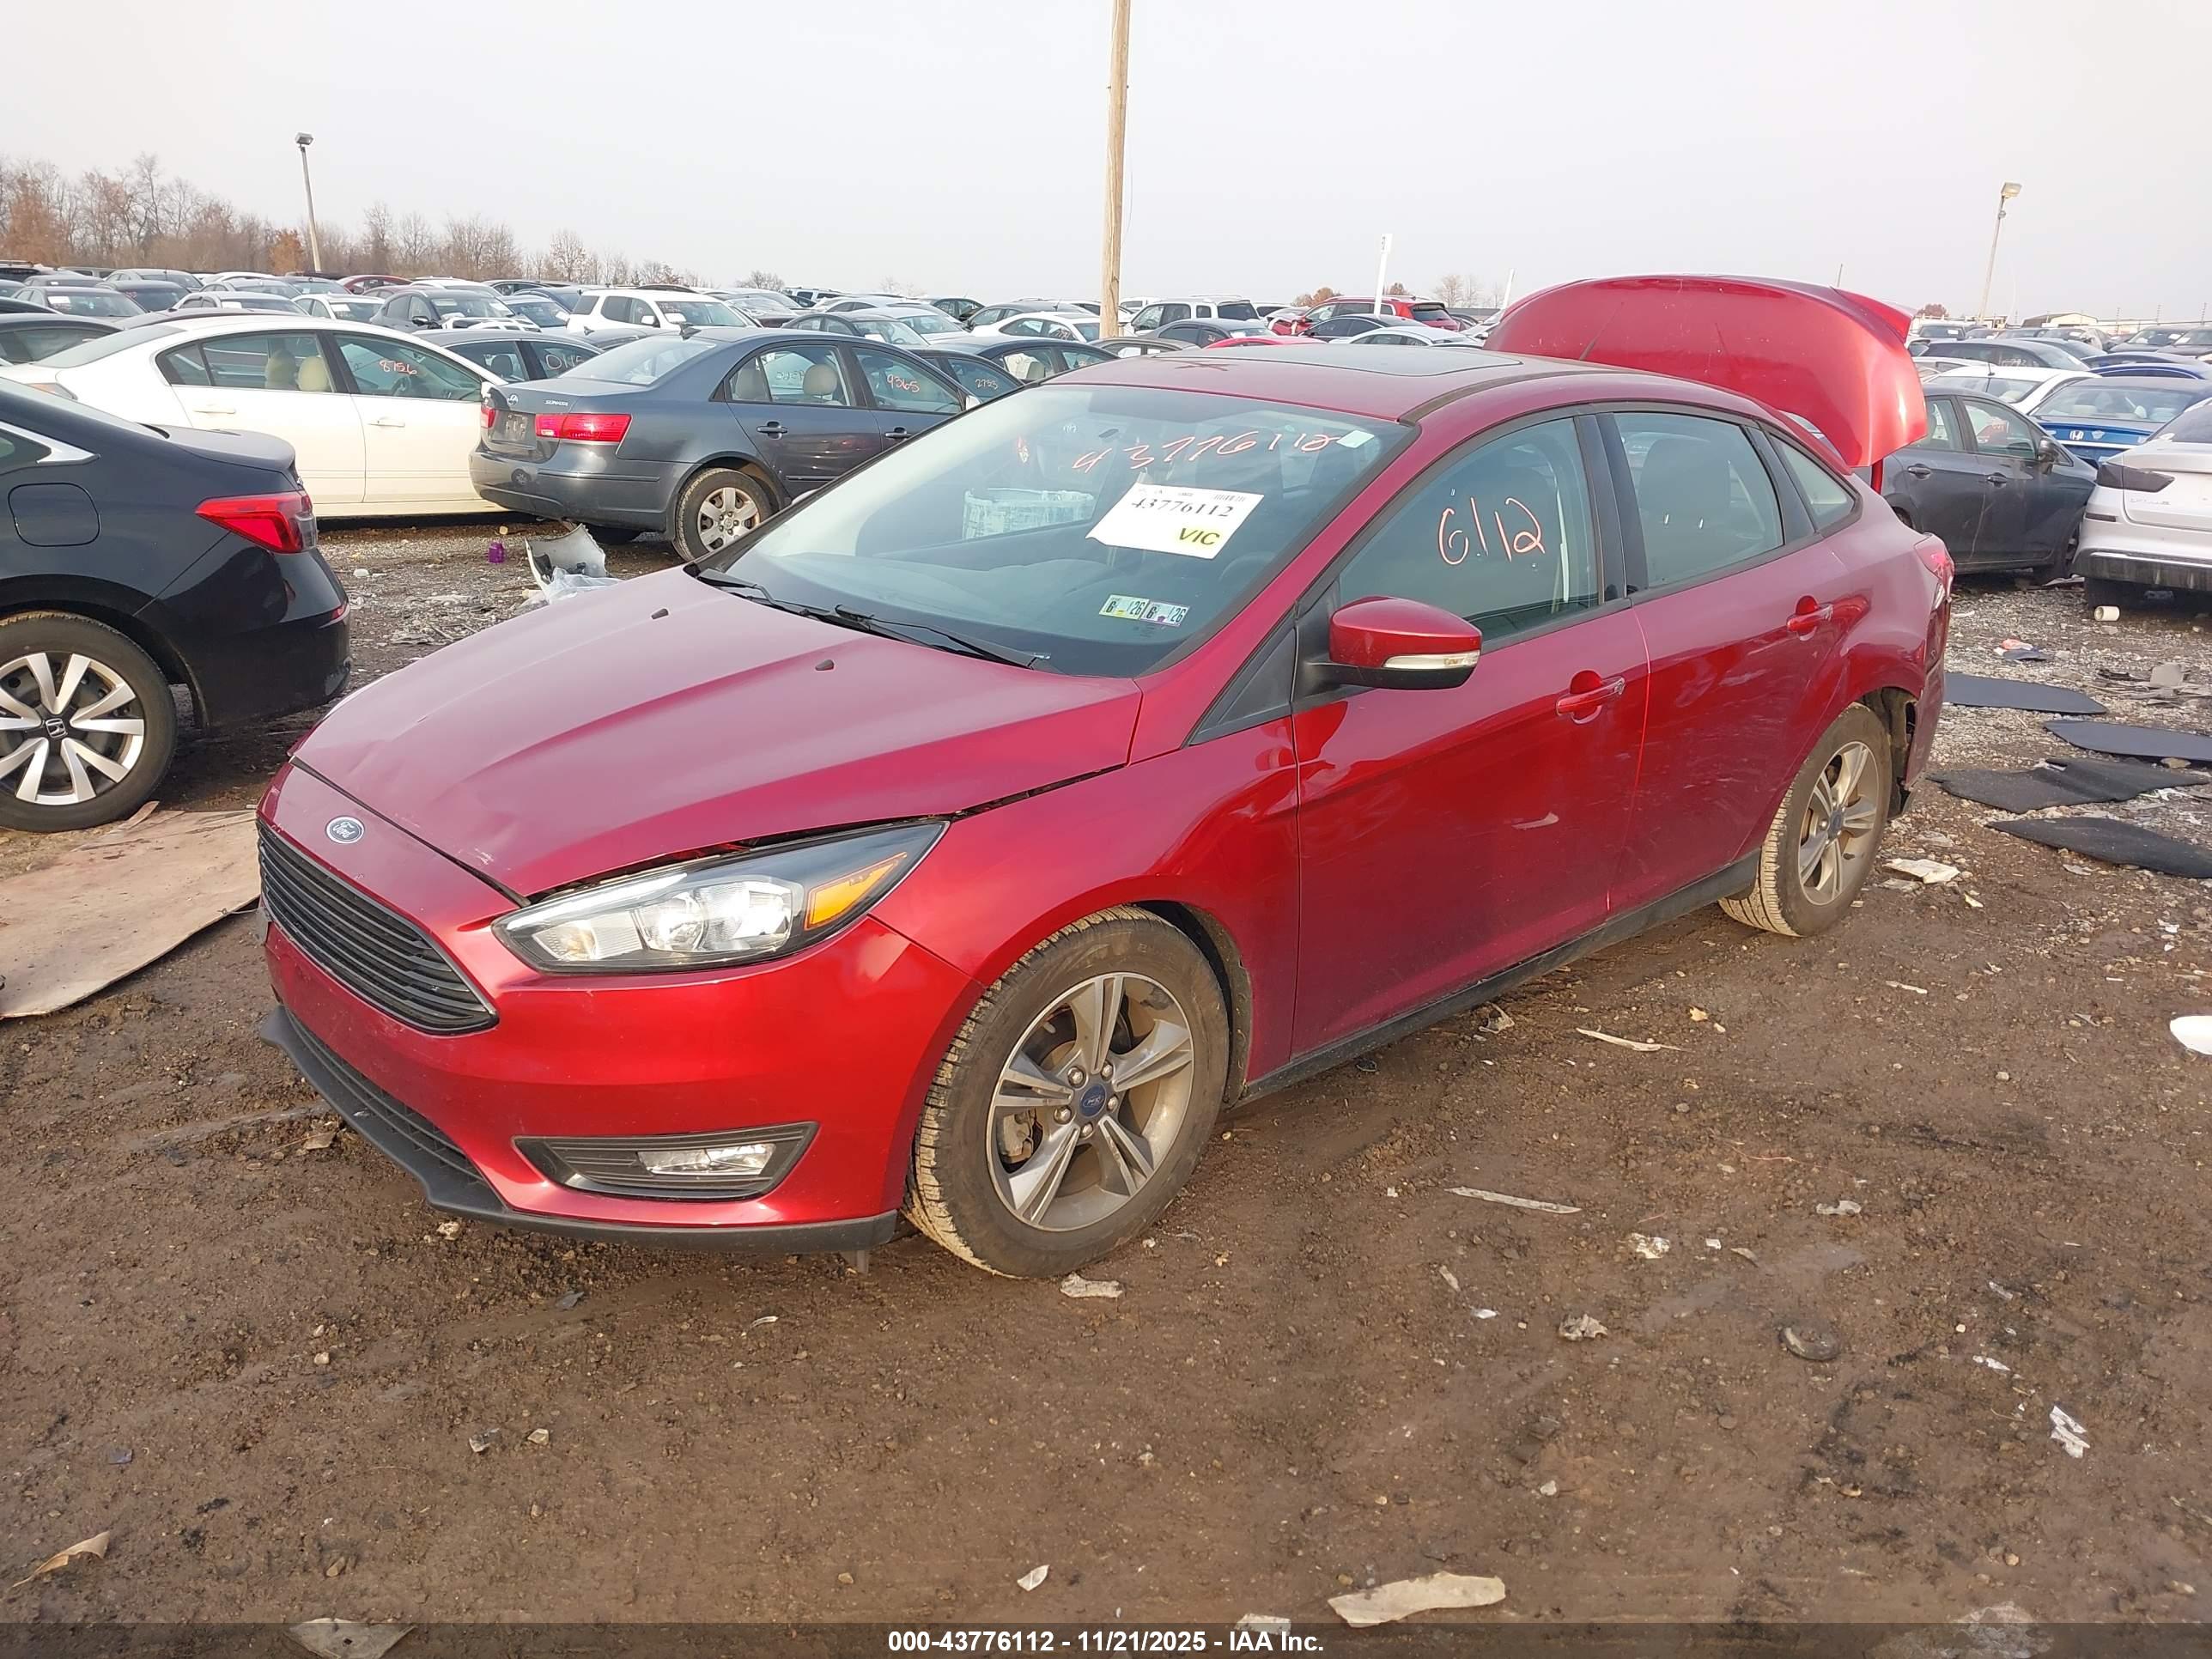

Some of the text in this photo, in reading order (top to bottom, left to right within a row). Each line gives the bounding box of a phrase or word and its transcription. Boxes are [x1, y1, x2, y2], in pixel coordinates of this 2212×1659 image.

[886, 374, 921, 393] 9365
[1131, 497, 1234, 517] 43776112
[1179, 527, 1220, 545] VIC
[1438, 496, 1546, 566] 6112
